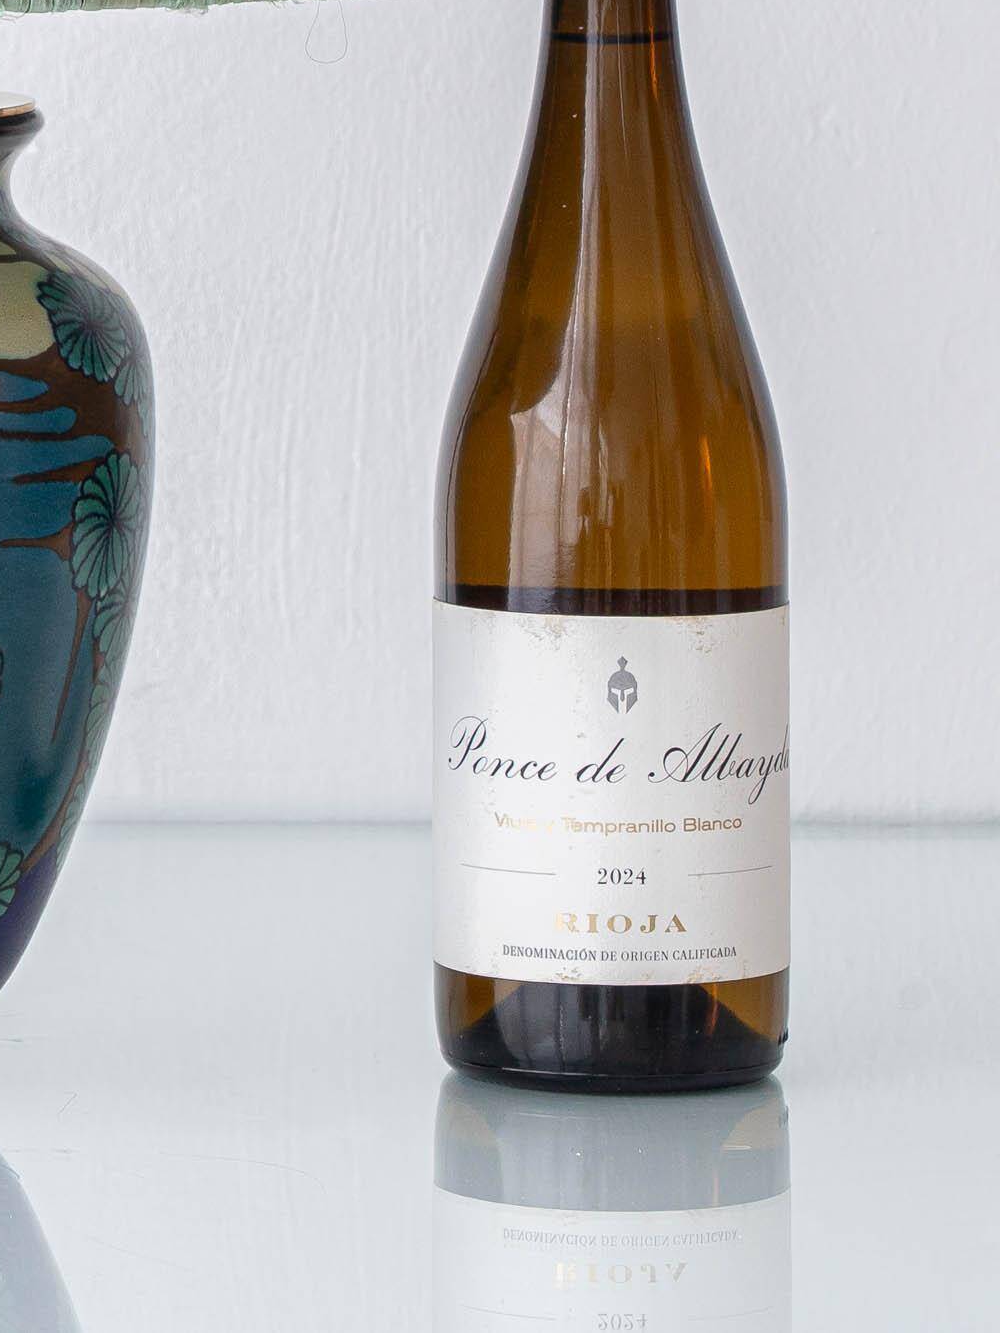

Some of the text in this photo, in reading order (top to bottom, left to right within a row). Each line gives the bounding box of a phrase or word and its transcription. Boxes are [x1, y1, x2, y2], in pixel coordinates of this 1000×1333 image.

[448, 715, 557, 781] Ponce
[576, 737, 626, 783] de
[560, 816, 676, 836] Tempranillo
[683, 817, 742, 832] Blanco
[597, 867, 647, 885] 2024
[556, 913, 687, 933] RIOJA
[503, 945, 737, 961] DENOMINACIÓN DE ORIGEN CALIFICADA
